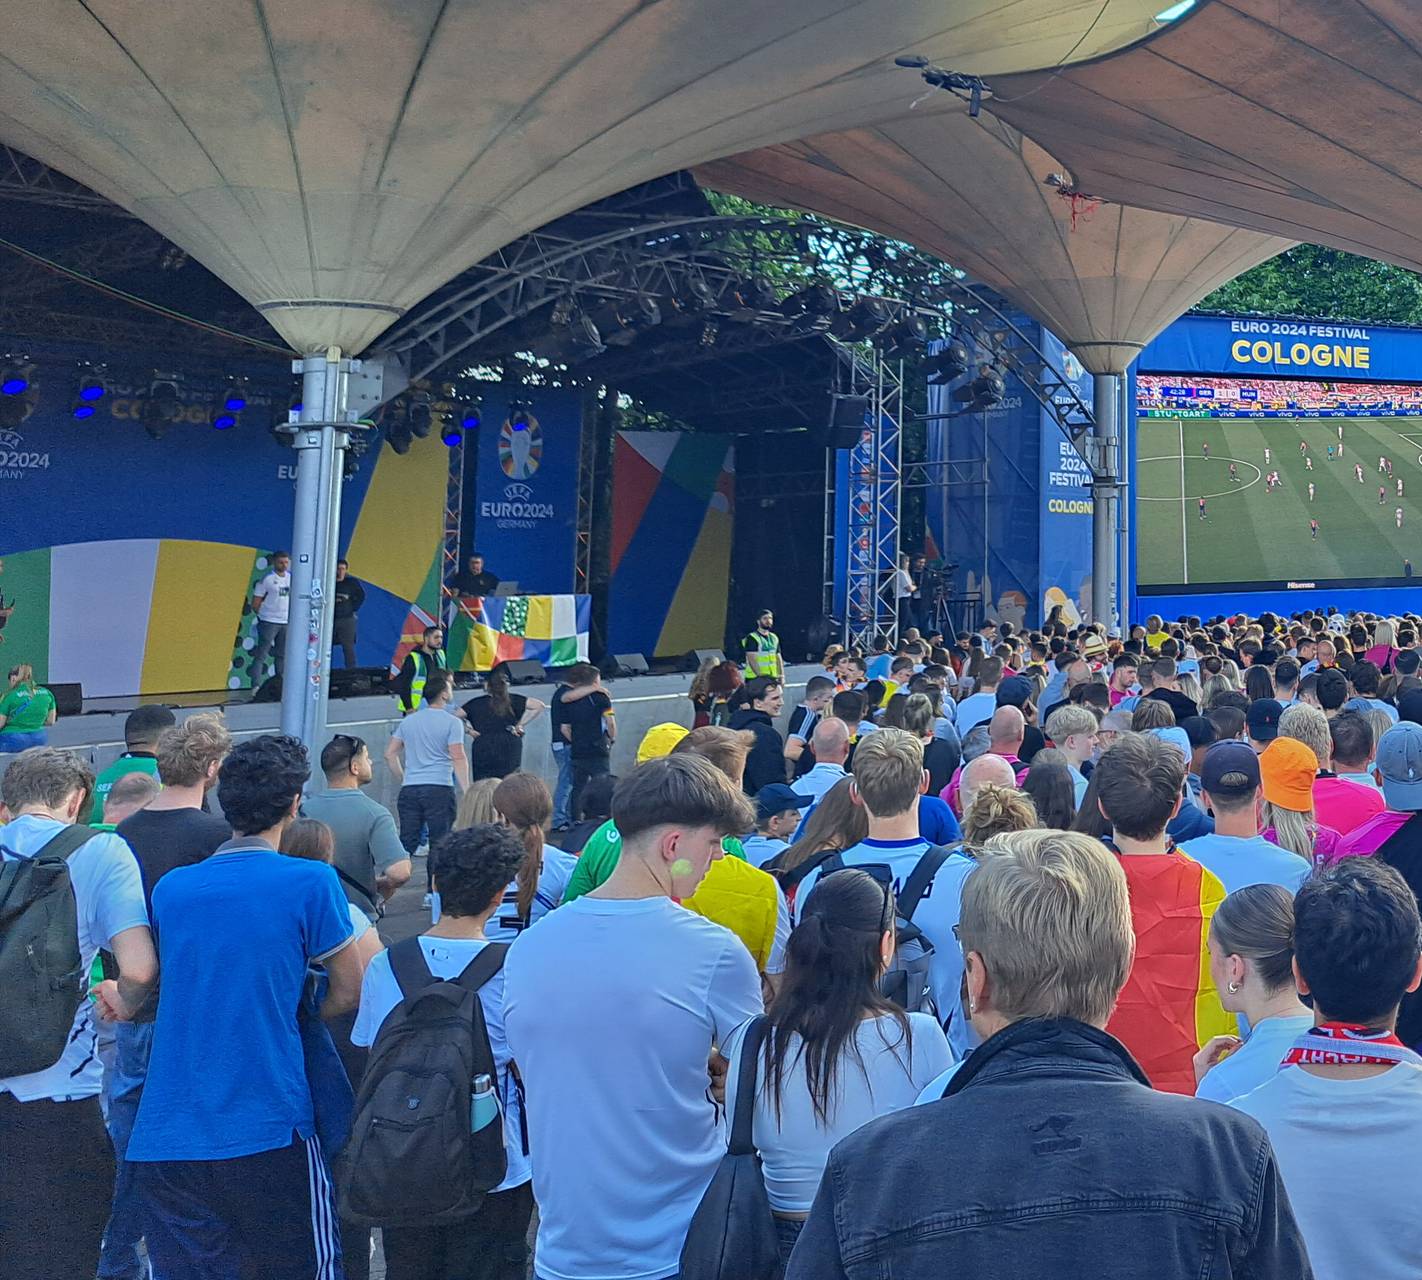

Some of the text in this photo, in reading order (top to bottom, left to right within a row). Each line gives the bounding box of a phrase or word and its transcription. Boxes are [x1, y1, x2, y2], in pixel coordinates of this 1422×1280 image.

[1231, 321, 1370, 340] EURO 2024 FESTIVAL
[1231, 339, 1370, 368] COLOGNE
[1060, 457, 1087, 471] 2024
[481, 502, 555, 518] EURO2024
[1048, 499, 1094, 514] COLOGN
[496, 519, 537, 528] GERMANY
